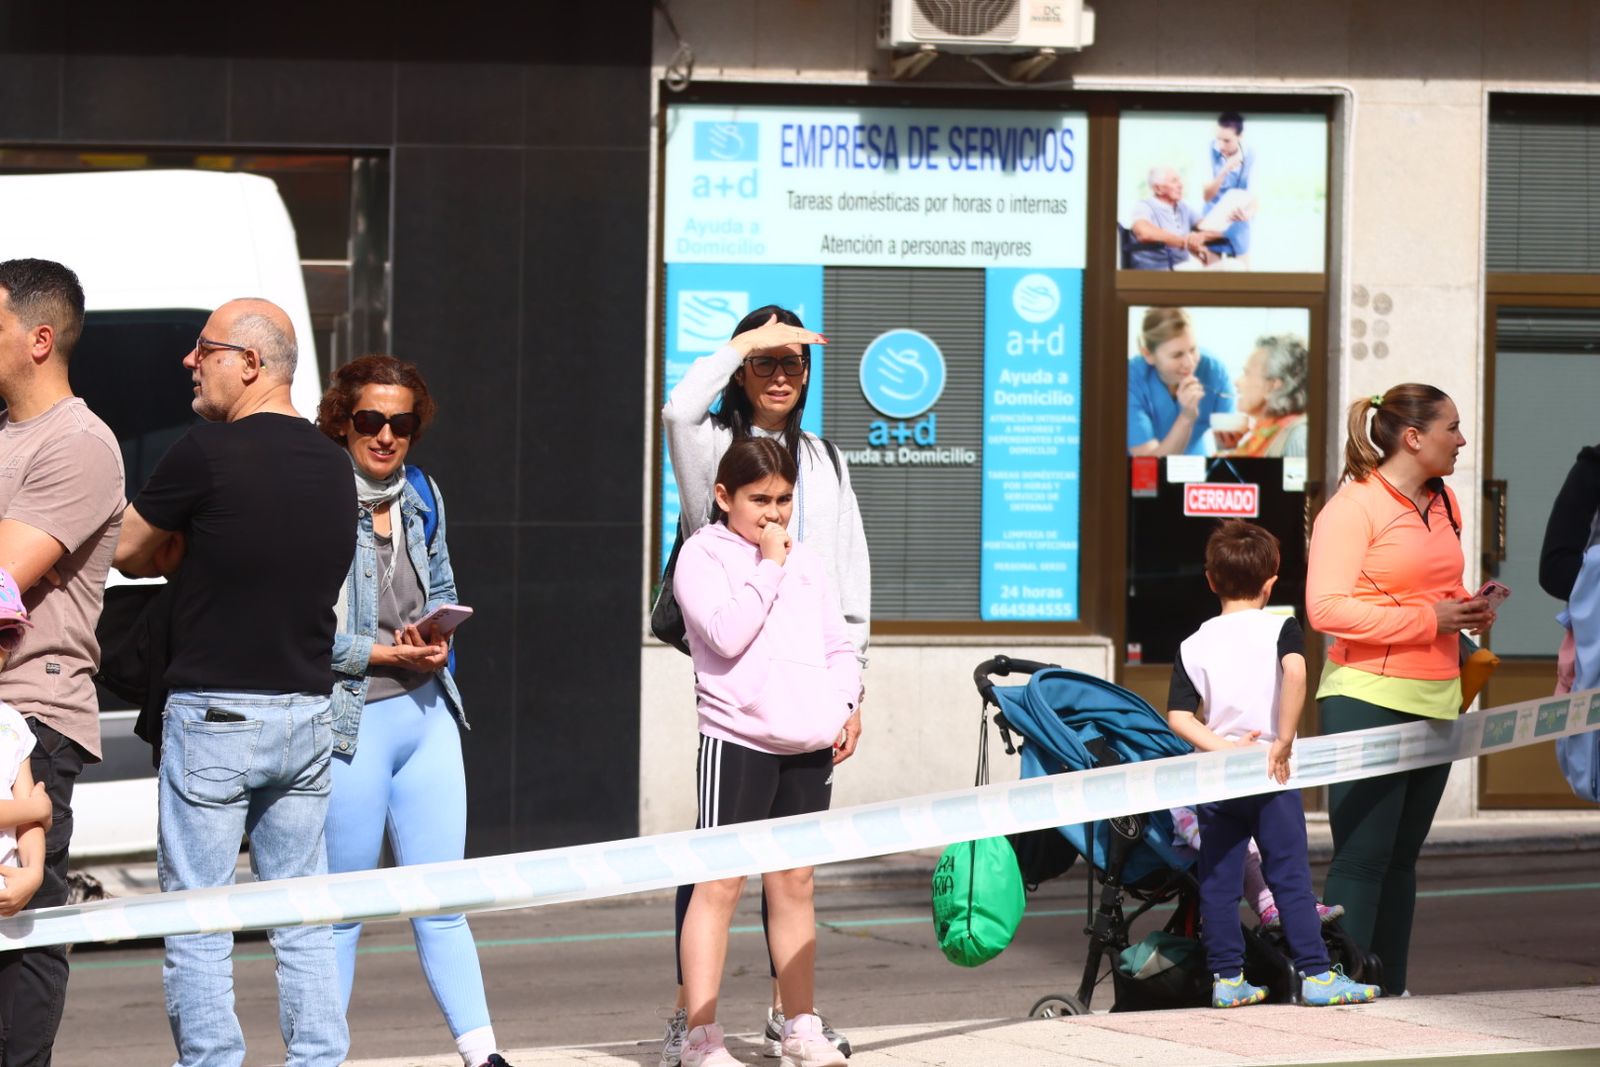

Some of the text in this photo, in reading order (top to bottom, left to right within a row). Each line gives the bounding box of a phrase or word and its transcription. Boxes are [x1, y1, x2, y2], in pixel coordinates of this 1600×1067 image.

[780, 123, 1075, 172] EMPRESA DE SERVICIOS
[692, 168, 758, 199] a+d
[787, 190, 1067, 217] Tareas domésticas por horas o internas
[684, 217, 760, 237] Ayuda a
[677, 238, 765, 256] Domicilio
[820, 234, 1031, 261] Atención a personas mayores
[1006, 323, 1065, 356] a+d
[999, 368, 1068, 387] Ayuda a
[993, 390, 1074, 406] Domicilio
[868, 412, 937, 446] a+d
[842, 447, 976, 465] yuda a Domicilio
[1188, 489, 1254, 511] CERRADO
[1001, 584, 1063, 599] 24 horas
